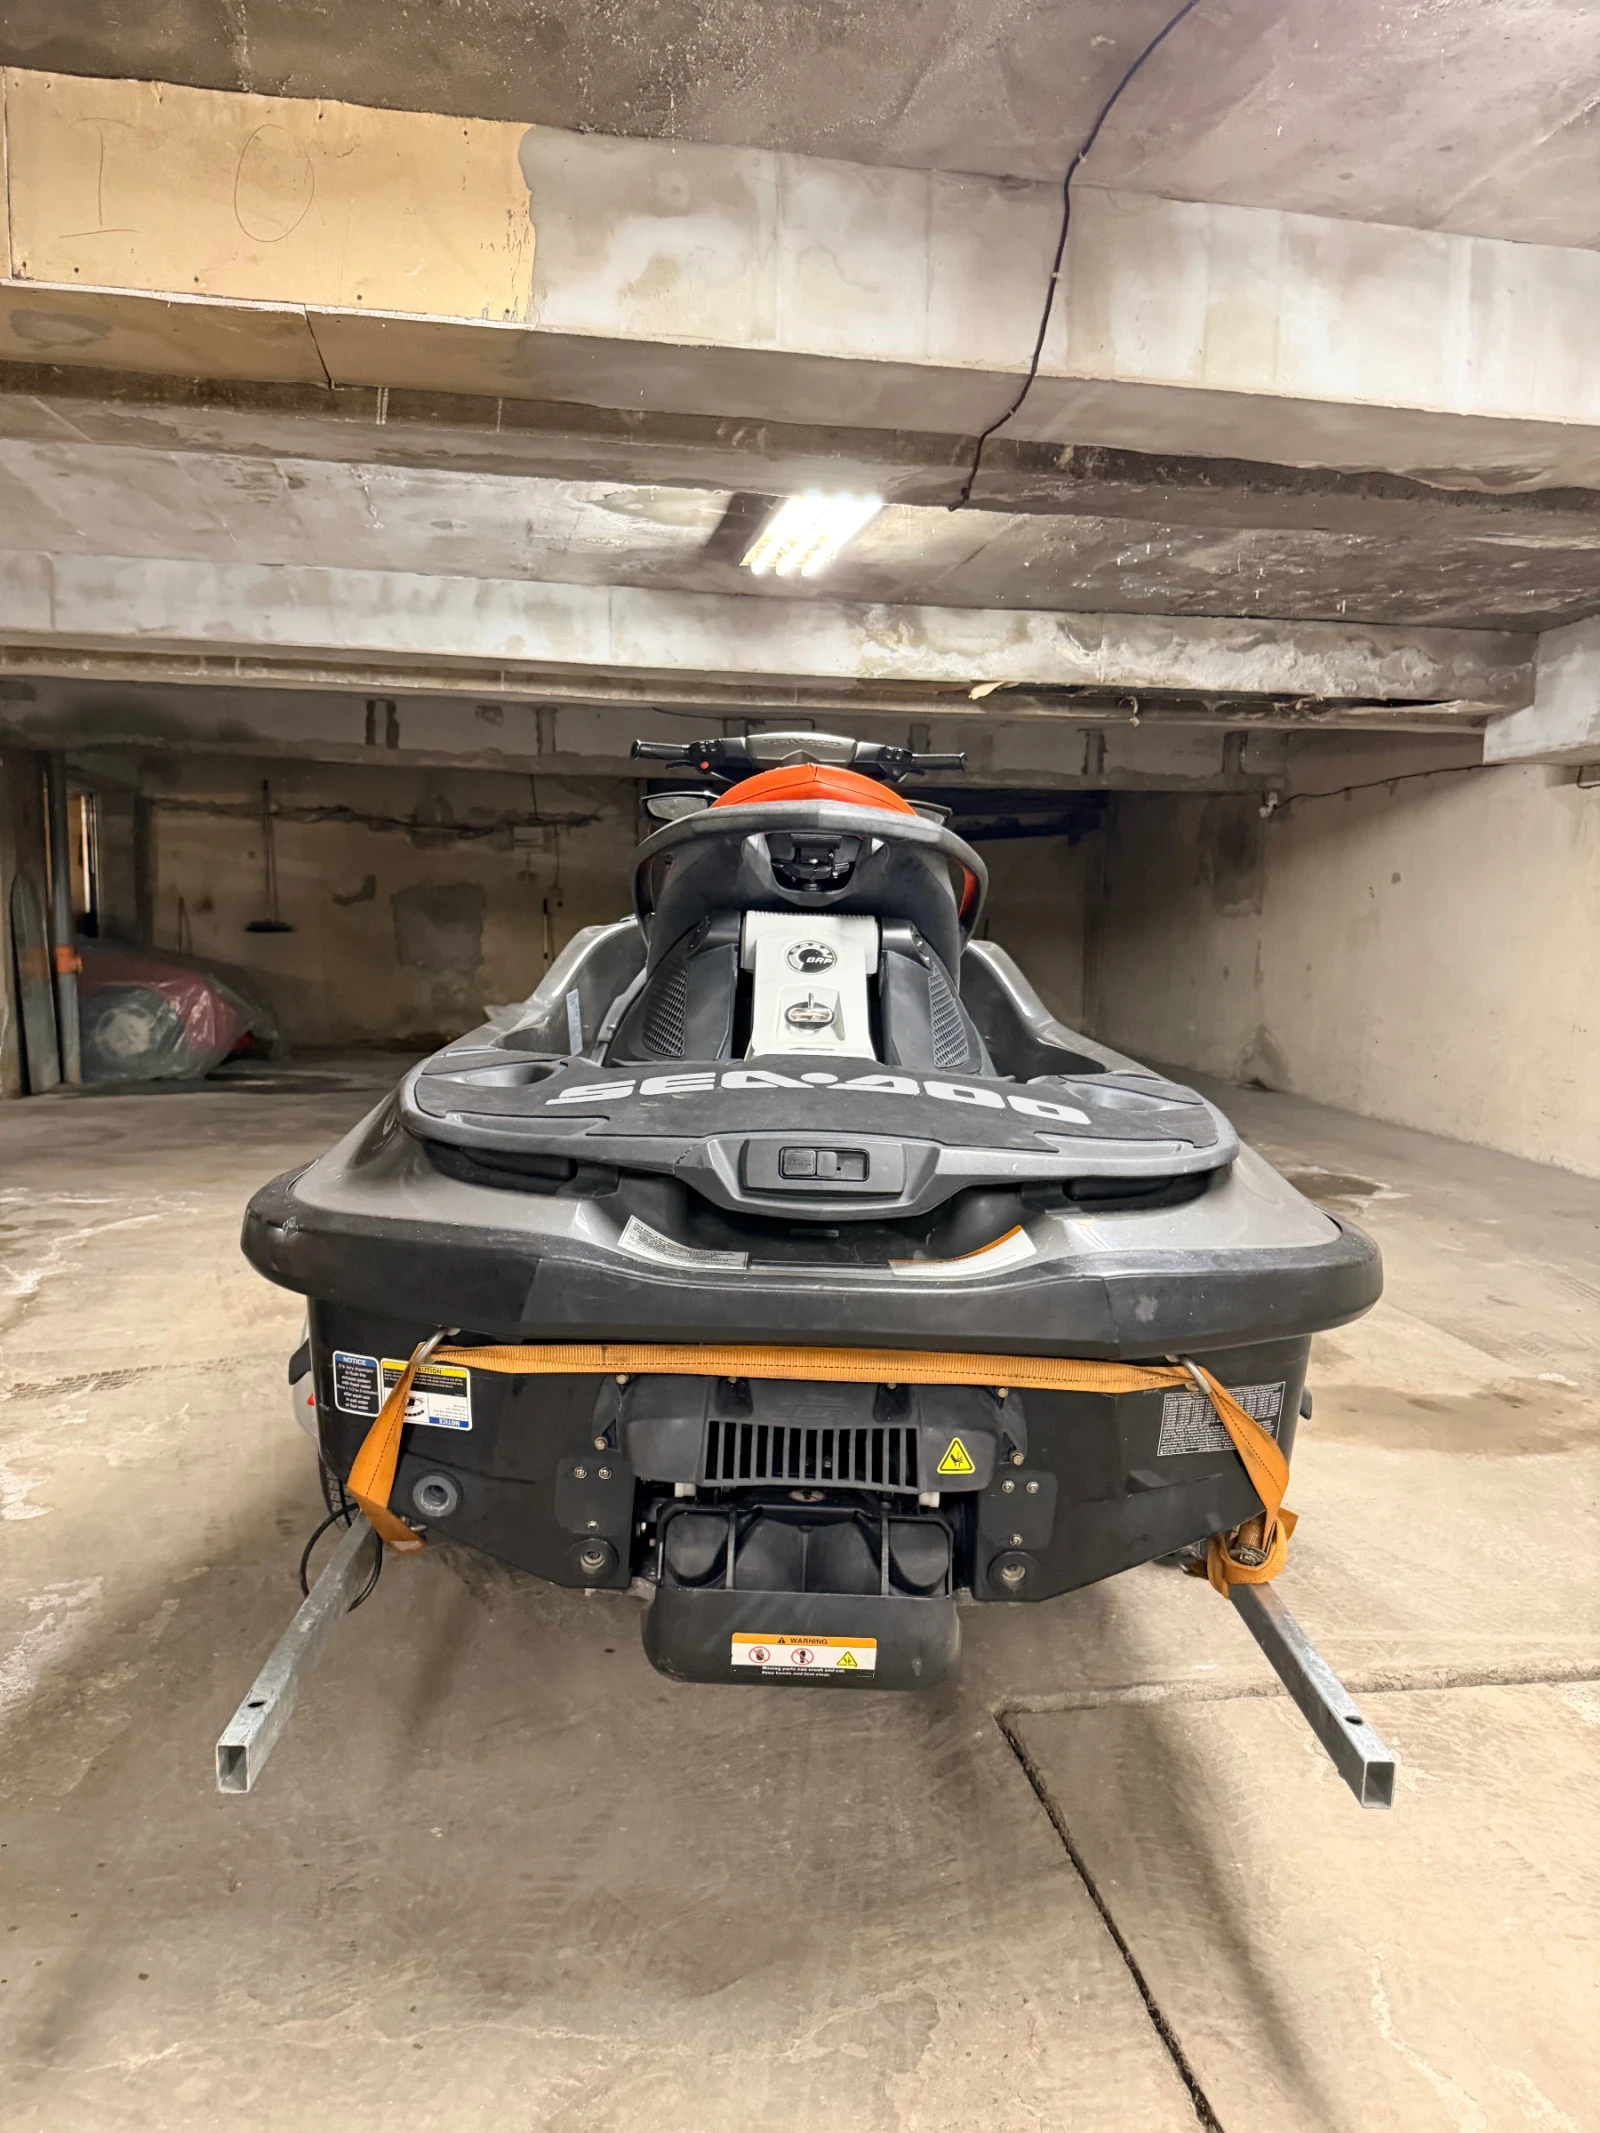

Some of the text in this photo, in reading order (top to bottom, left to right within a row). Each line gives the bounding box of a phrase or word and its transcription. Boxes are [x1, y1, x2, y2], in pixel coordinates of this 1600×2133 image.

[805, 956, 833, 964] BRP
[343, 1356, 366, 1365] NOTICE
[439, 1418, 460, 1427] NOTICE
